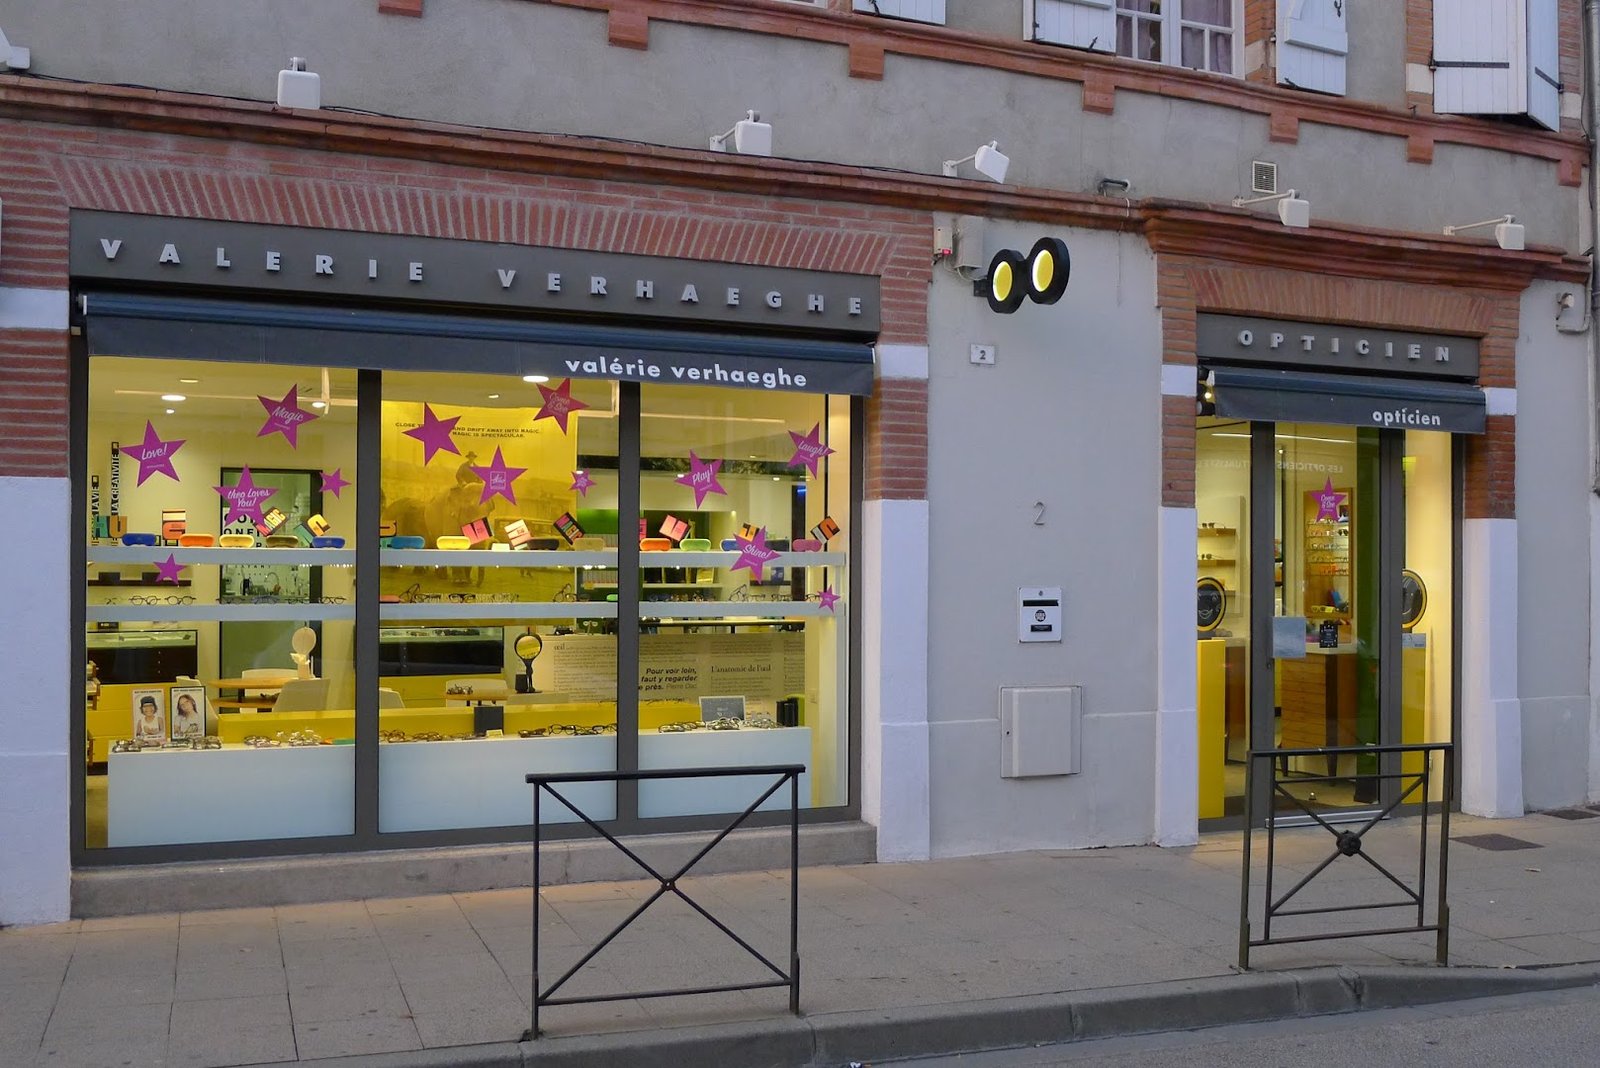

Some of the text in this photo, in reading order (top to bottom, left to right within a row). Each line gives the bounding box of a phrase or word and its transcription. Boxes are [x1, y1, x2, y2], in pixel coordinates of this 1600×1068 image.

[100, 238, 861, 315] VALERIE VERHAEGHE
[979, 349, 987, 361] 2
[1238, 330, 1449, 362] OPTICIEN
[565, 356, 807, 388] valérie verhaeghe
[272, 406, 304, 425] Magic
[1372, 408, 1441, 427] opticien
[141, 443, 168, 461] Love!
[798, 441, 828, 457] Laugh!
[692, 464, 713, 485] Play!
[227, 488, 271, 499] theo Loves
[237, 497, 257, 508] You!
[1033, 501, 1045, 525] 2
[744, 543, 771, 559] Shine!
[646, 667, 664, 675] Pour
[664, 675, 698, 683] regarder
